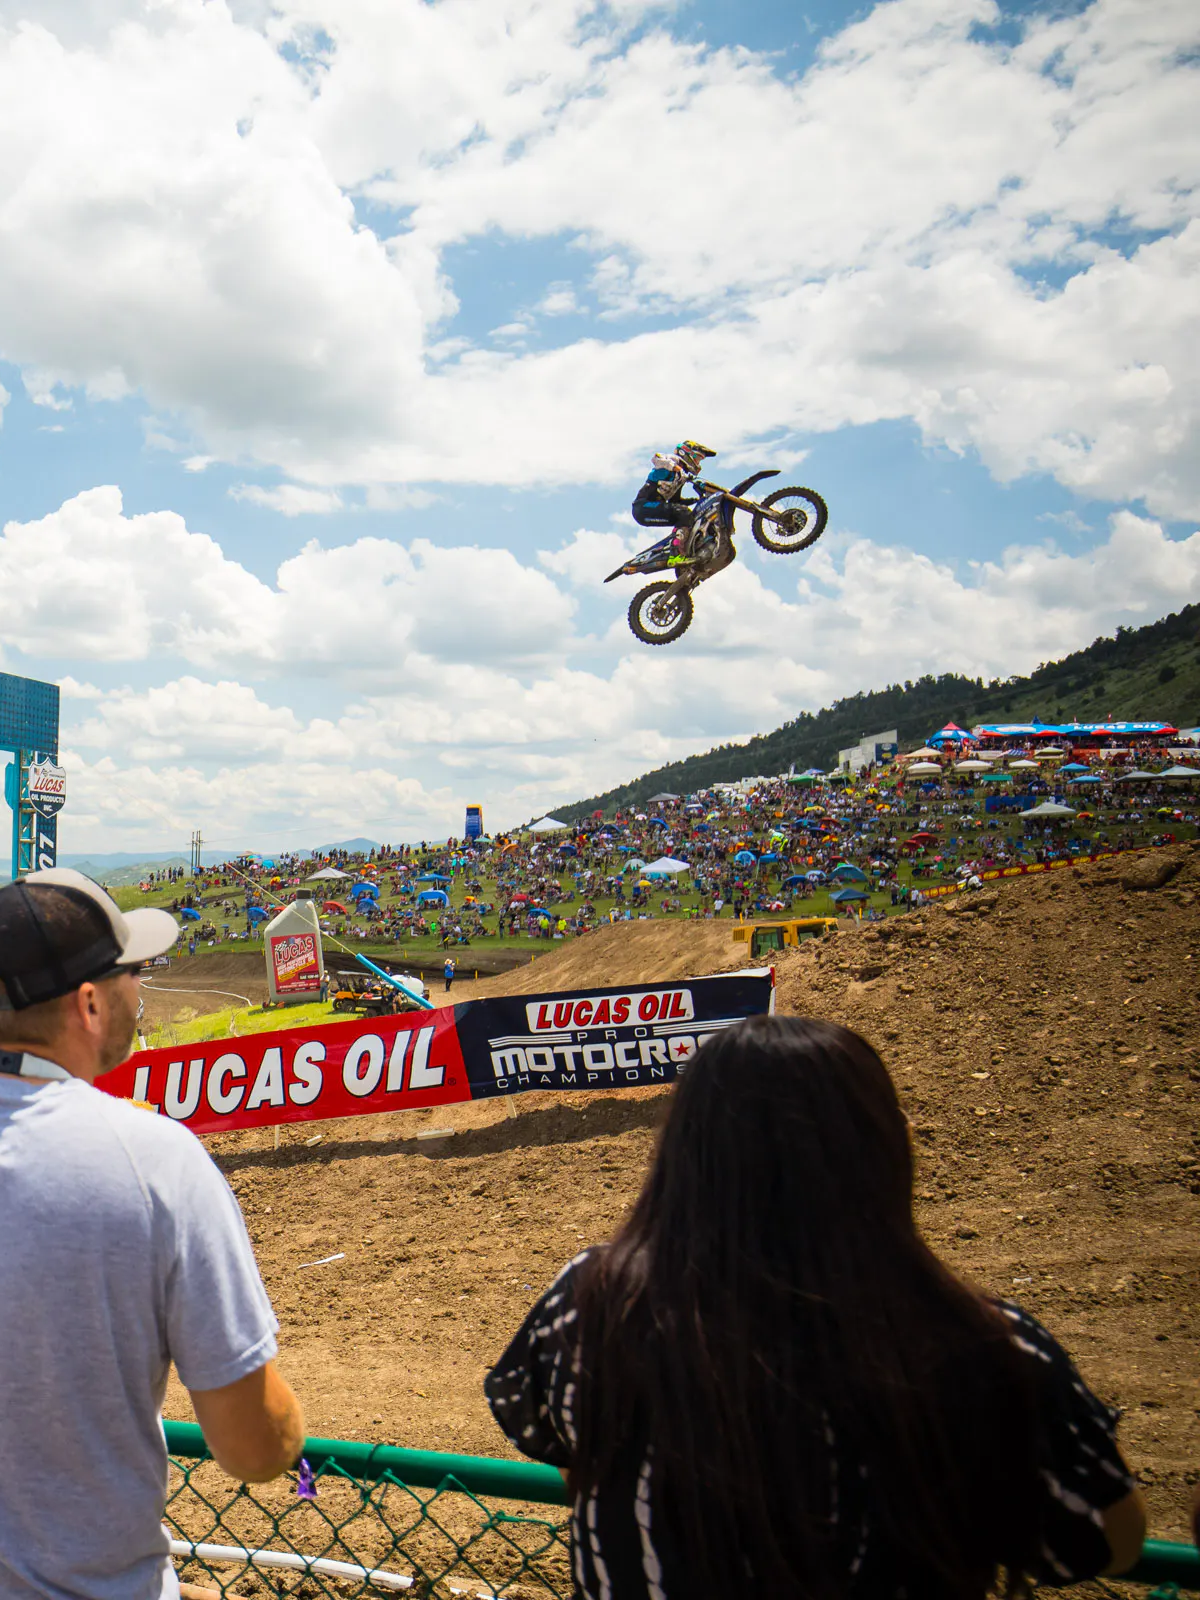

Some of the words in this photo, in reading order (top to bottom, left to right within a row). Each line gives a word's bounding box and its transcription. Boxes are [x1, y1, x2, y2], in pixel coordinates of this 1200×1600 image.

[31, 793, 39, 801] OIL
[40, 794, 65, 804] PRODUCTS
[33, 777, 65, 793] LUCAS
[275, 936, 314, 967] LUCAS
[536, 997, 632, 1030] LUCAS
[638, 992, 687, 1022] OIL
[576, 1027, 648, 1042] PRO
[490, 1033, 710, 1078] MOTOCRO
[132, 1040, 327, 1121] LUCAS
[342, 1025, 446, 1098] OIL
[496, 1064, 688, 1089] CHAMPIONS
